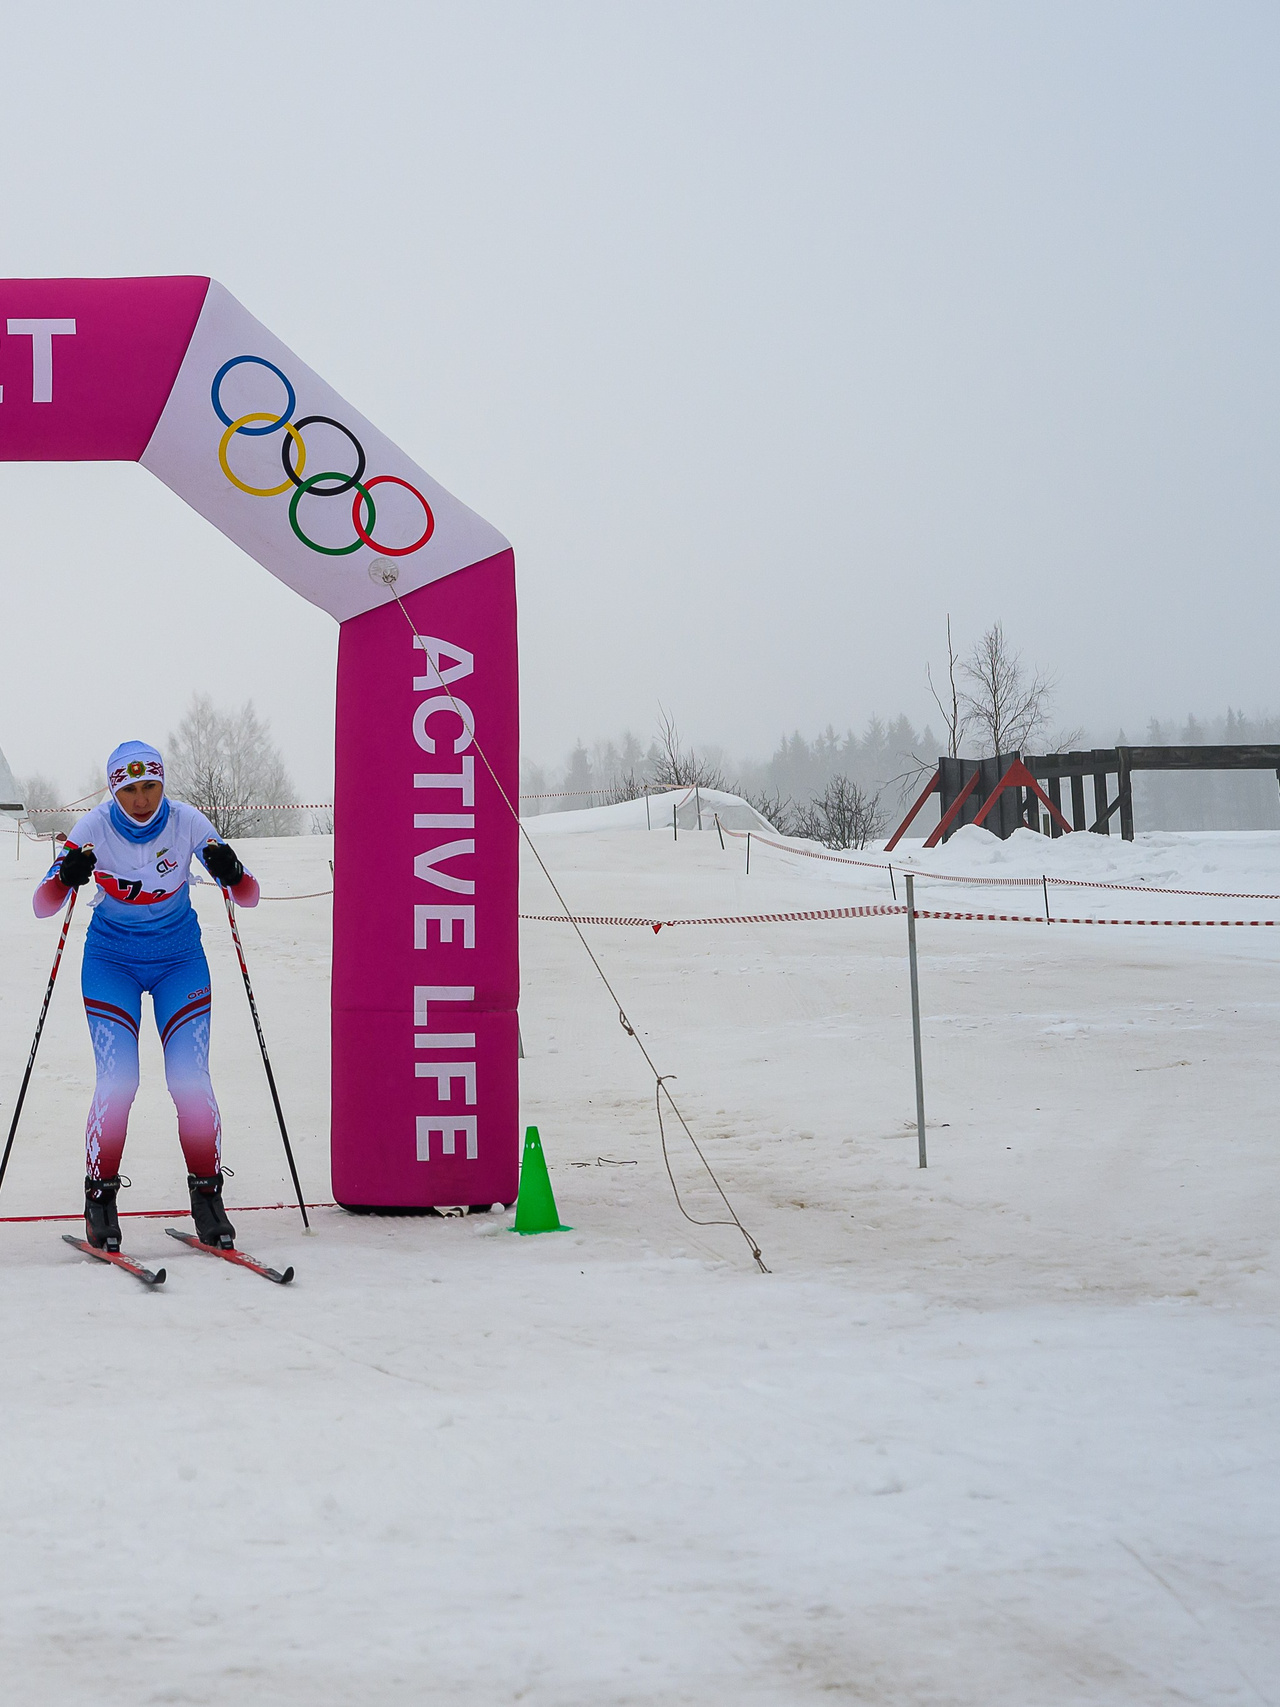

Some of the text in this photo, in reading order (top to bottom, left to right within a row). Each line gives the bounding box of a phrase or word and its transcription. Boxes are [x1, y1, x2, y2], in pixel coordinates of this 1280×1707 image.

[117, 878, 143, 901] 7
[412, 635, 478, 1162] ACTIVE LIFE
